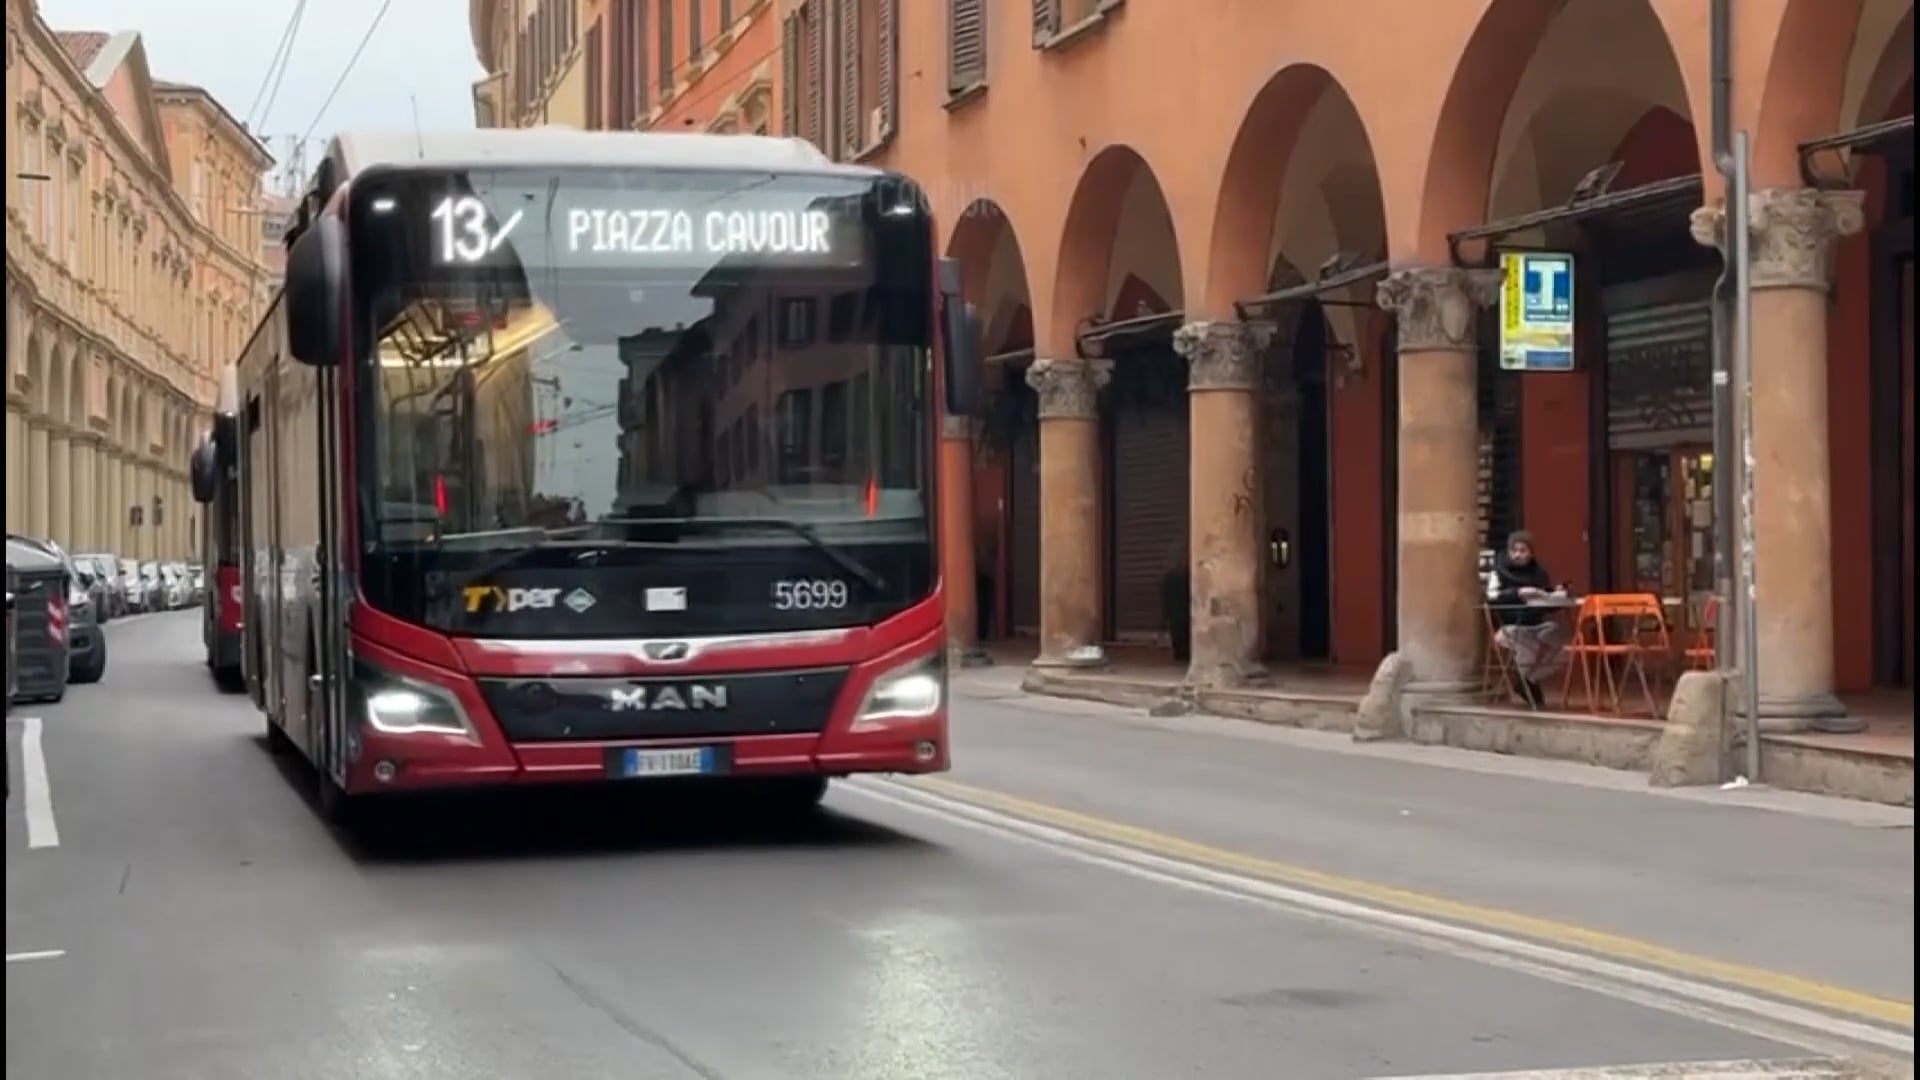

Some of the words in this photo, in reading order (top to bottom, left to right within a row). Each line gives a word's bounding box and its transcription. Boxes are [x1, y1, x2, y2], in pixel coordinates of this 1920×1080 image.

[568, 209, 692, 252] PIAZZA
[705, 210, 831, 253] CAVOUR
[774, 580, 848, 610] 5699
[610, 685, 727, 711] MAN
